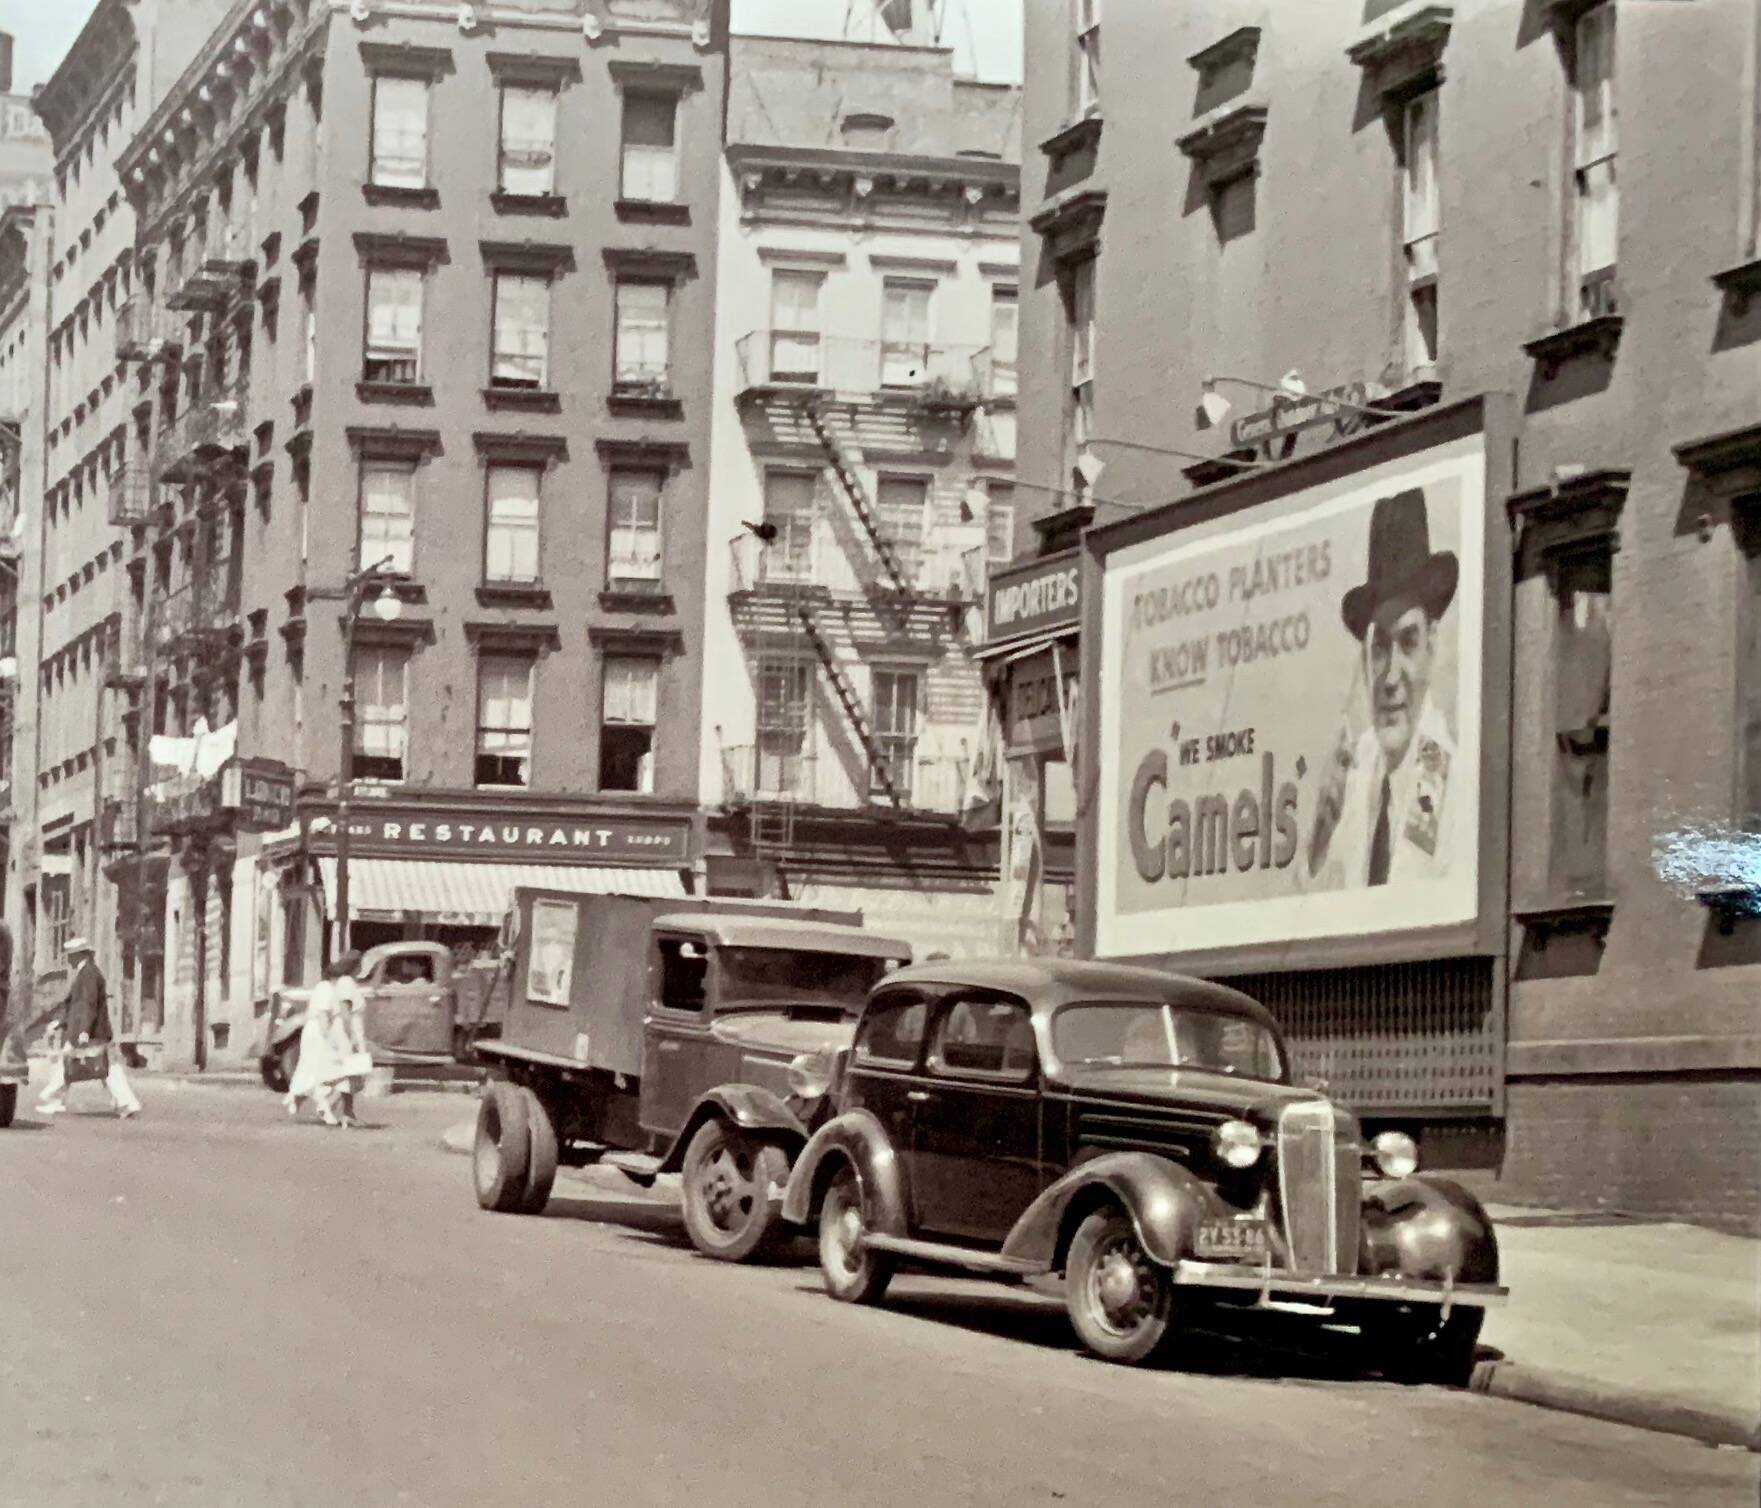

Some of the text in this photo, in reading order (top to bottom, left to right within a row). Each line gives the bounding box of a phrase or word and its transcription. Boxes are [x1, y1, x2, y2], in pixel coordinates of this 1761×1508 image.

[994, 567, 1078, 625] IMPORTERS
[1134, 540, 1330, 629] TOBACCO PLANTERS
[1150, 612, 1310, 684] KNOW TOBACCO
[1206, 727, 1255, 762] SMOKE
[383, 821, 613, 847] RESTAURANT
